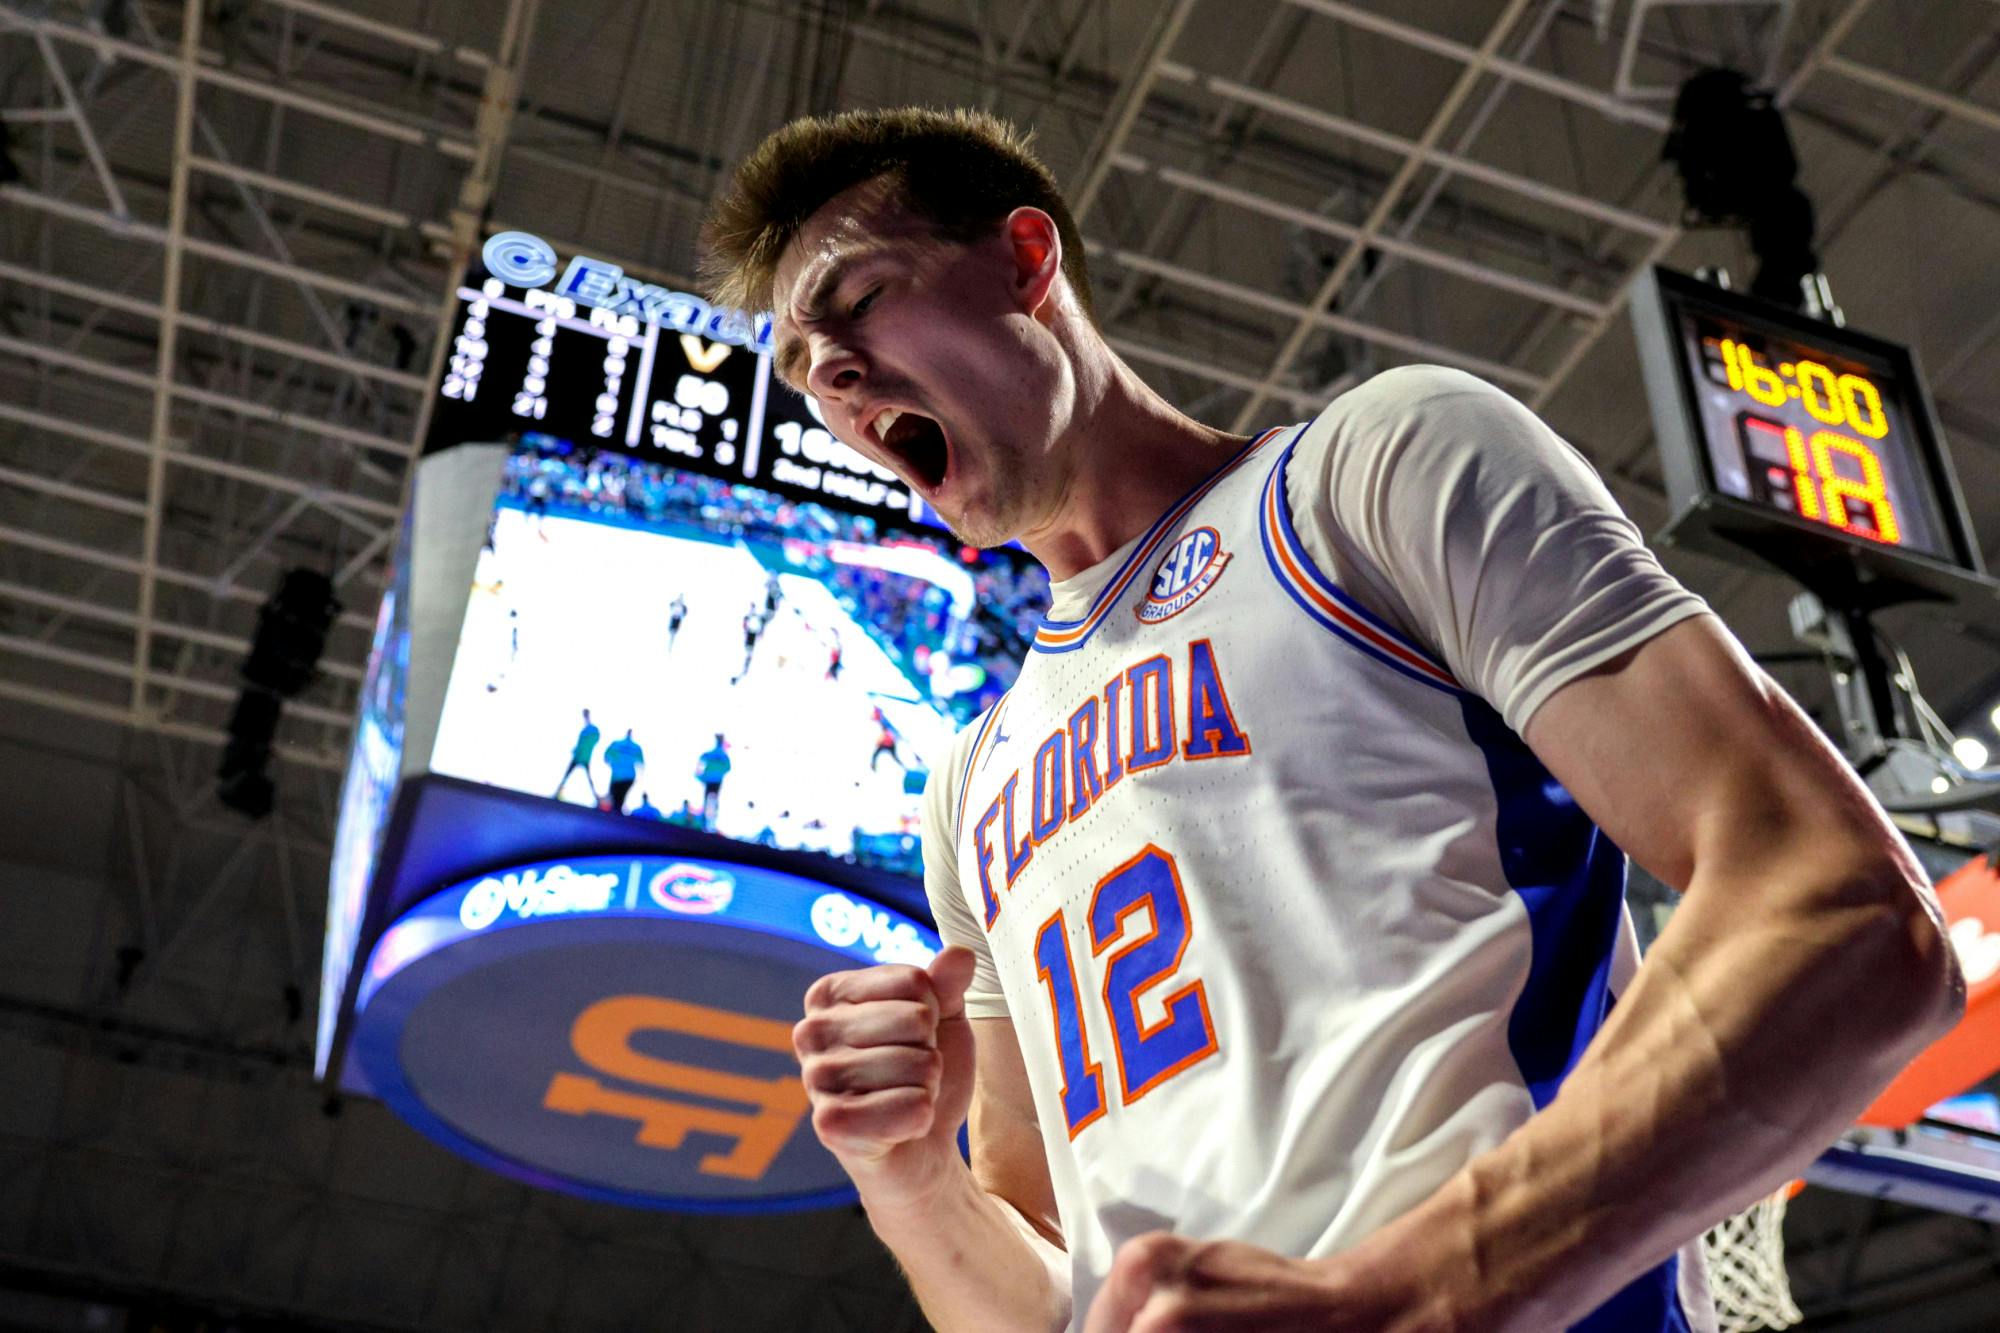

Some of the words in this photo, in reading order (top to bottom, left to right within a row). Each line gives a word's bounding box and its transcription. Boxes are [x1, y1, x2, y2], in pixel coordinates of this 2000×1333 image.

[680, 334, 731, 373] V
[1720, 339, 1889, 440] 16:00
[1142, 573, 1213, 619] GRADUATE
[1154, 532, 1212, 596] SEC
[973, 638, 1252, 934] FLORIDA
[1033, 842, 1220, 1142] 12
